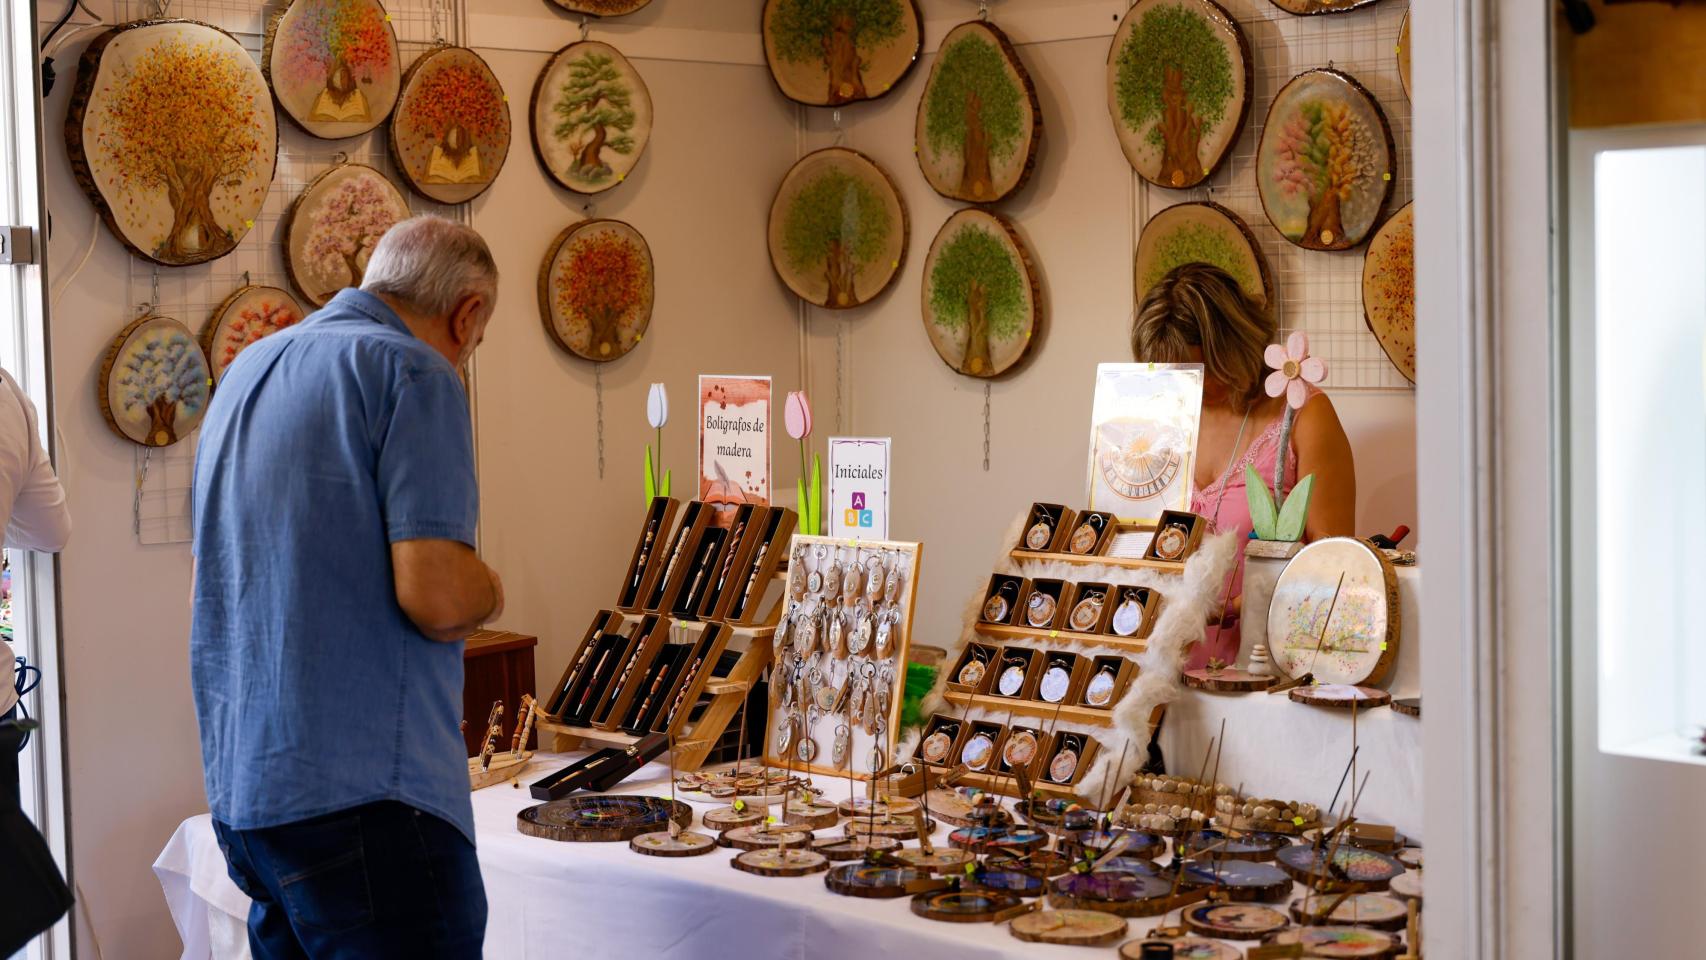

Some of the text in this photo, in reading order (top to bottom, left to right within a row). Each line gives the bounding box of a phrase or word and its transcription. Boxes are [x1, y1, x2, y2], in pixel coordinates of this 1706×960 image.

[752, 417, 765, 433] de
[717, 442, 752, 458] madera
[835, 464, 883, 479] Iniciales
[854, 495, 863, 507] A
[862, 513, 870, 524] C
[876, 632, 887, 644] M
